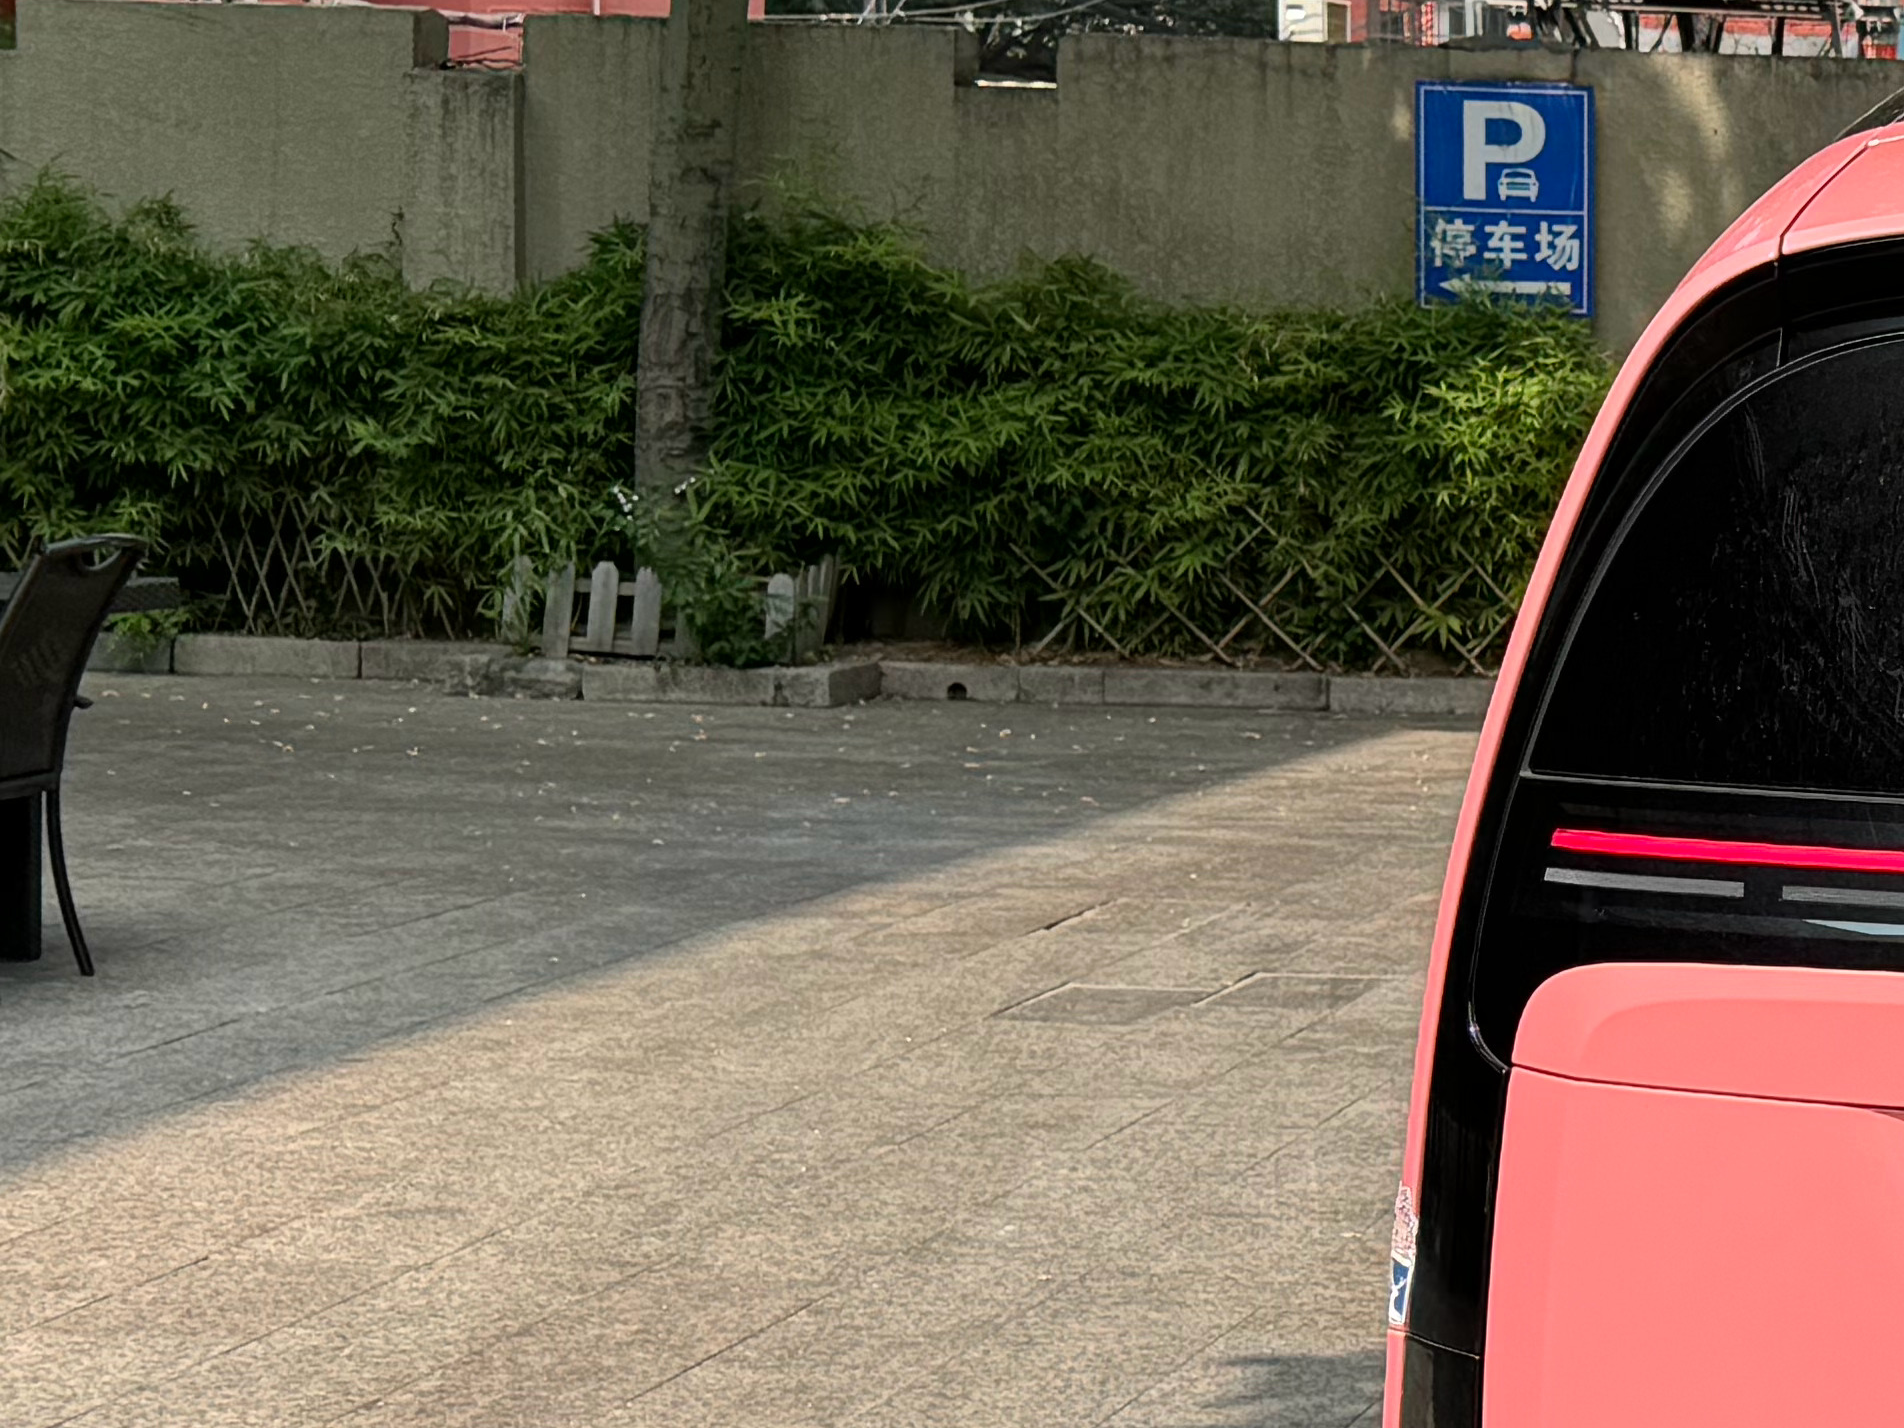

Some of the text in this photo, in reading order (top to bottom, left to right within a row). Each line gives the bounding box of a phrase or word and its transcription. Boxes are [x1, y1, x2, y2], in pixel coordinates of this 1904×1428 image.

[1463, 100, 1546, 200] P
[1430, 218, 1580, 271] 停车场
